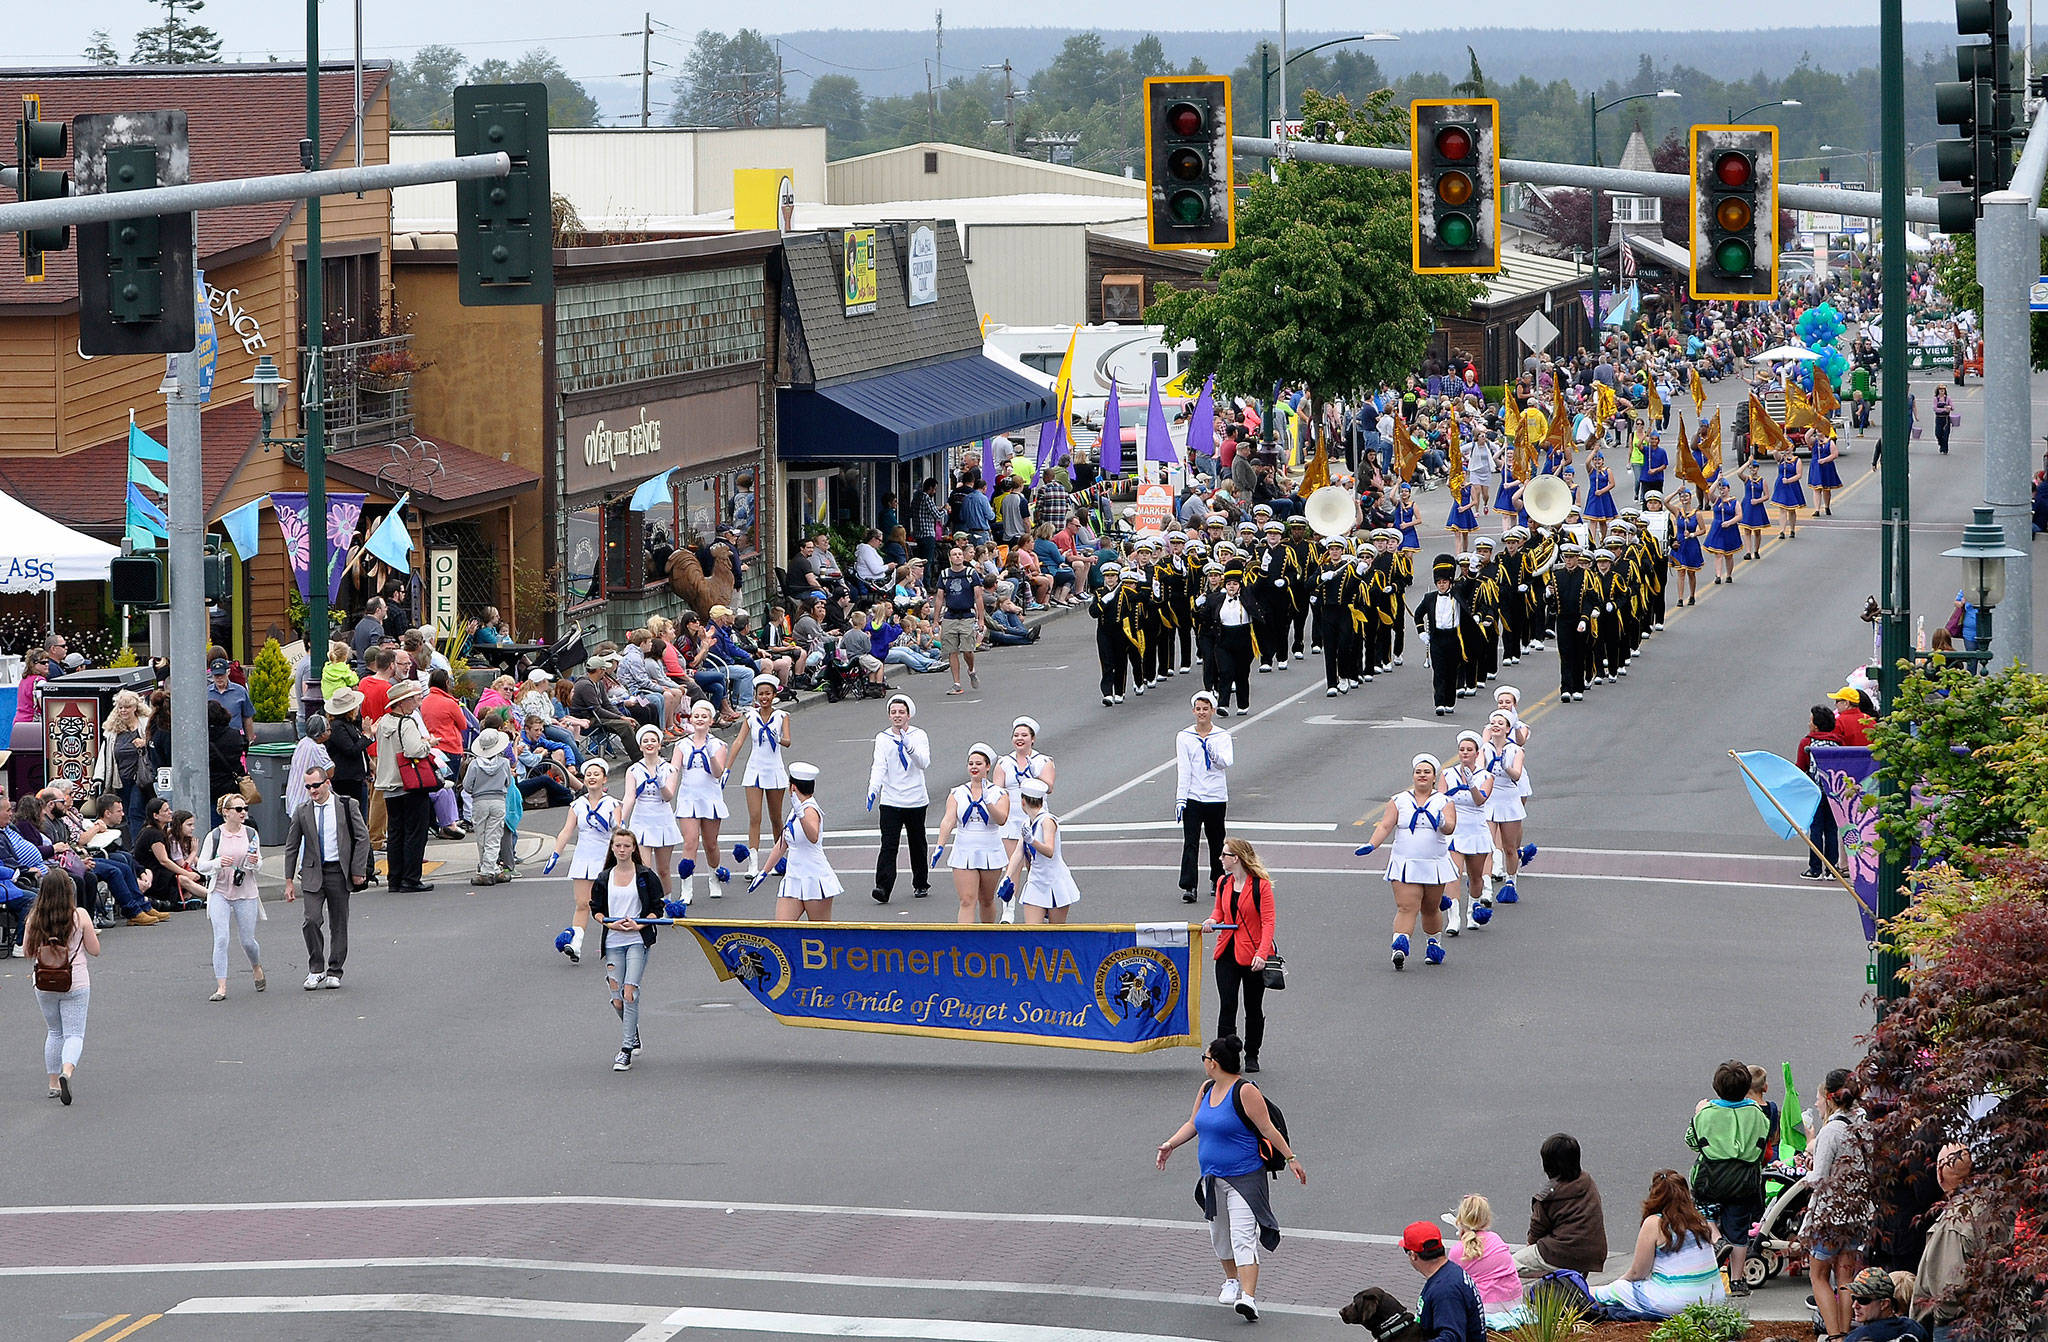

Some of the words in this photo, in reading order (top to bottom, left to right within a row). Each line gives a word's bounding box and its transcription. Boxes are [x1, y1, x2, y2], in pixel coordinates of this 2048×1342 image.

[1276, 125, 1304, 135] EXP
[1638, 269, 1659, 278] PARK
[204, 282, 267, 355] ENCE
[1907, 348, 1922, 356] PIC
[1924, 346, 1949, 355] VIEW
[1932, 356, 1955, 364] SCHOO
[584, 420, 616, 472] OVER
[613, 431, 629, 456] THE
[629, 406, 661, 456] FENCE
[1137, 505, 1171, 516] MARKET
[1142, 516, 1162, 525] TODA
[0, 557, 55, 585] ASS
[436, 556, 453, 632] OPEN
[739, 933, 766, 943] HIGH
[768, 943, 790, 977] SCHOOL
[1096, 950, 1128, 997] BREMERTON
[1132, 948, 1160, 960] HIGH
[1161, 958, 1179, 994] SCHOOL
[791, 986, 835, 1007] The
[841, 990, 904, 1014] Pride
[910, 993, 940, 1023] of
[939, 997, 1008, 1027] Puget
[1012, 1001, 1093, 1028] Sound
